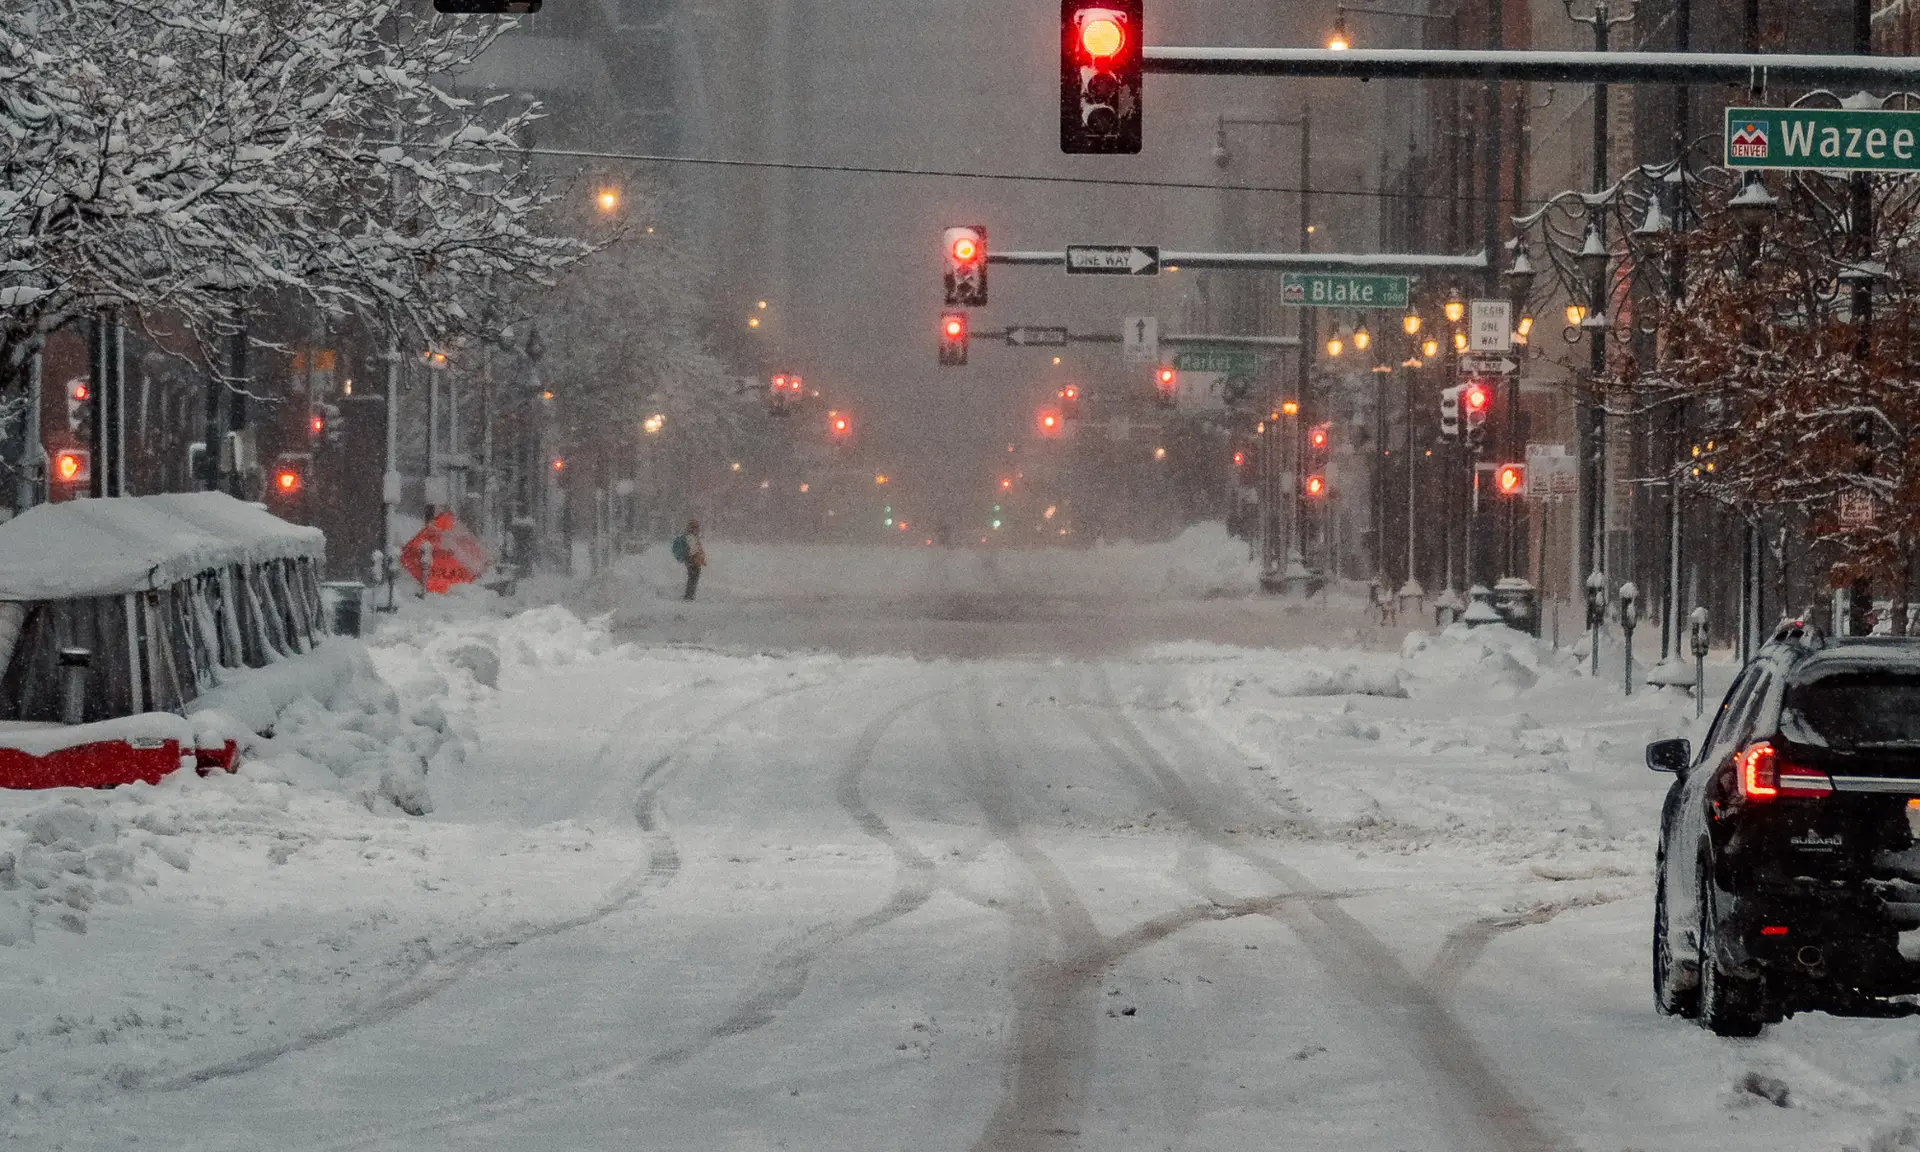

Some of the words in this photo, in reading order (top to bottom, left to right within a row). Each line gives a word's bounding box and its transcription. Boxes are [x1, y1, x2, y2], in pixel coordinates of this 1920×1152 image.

[1780, 120, 1915, 159] Wazee
[1732, 144, 1767, 157] DENVER
[1105, 252, 1130, 267] WAY
[1311, 279, 1374, 302] Blake
[1481, 336, 1499, 346] WAY
[1790, 837, 1842, 845] SUBARU
